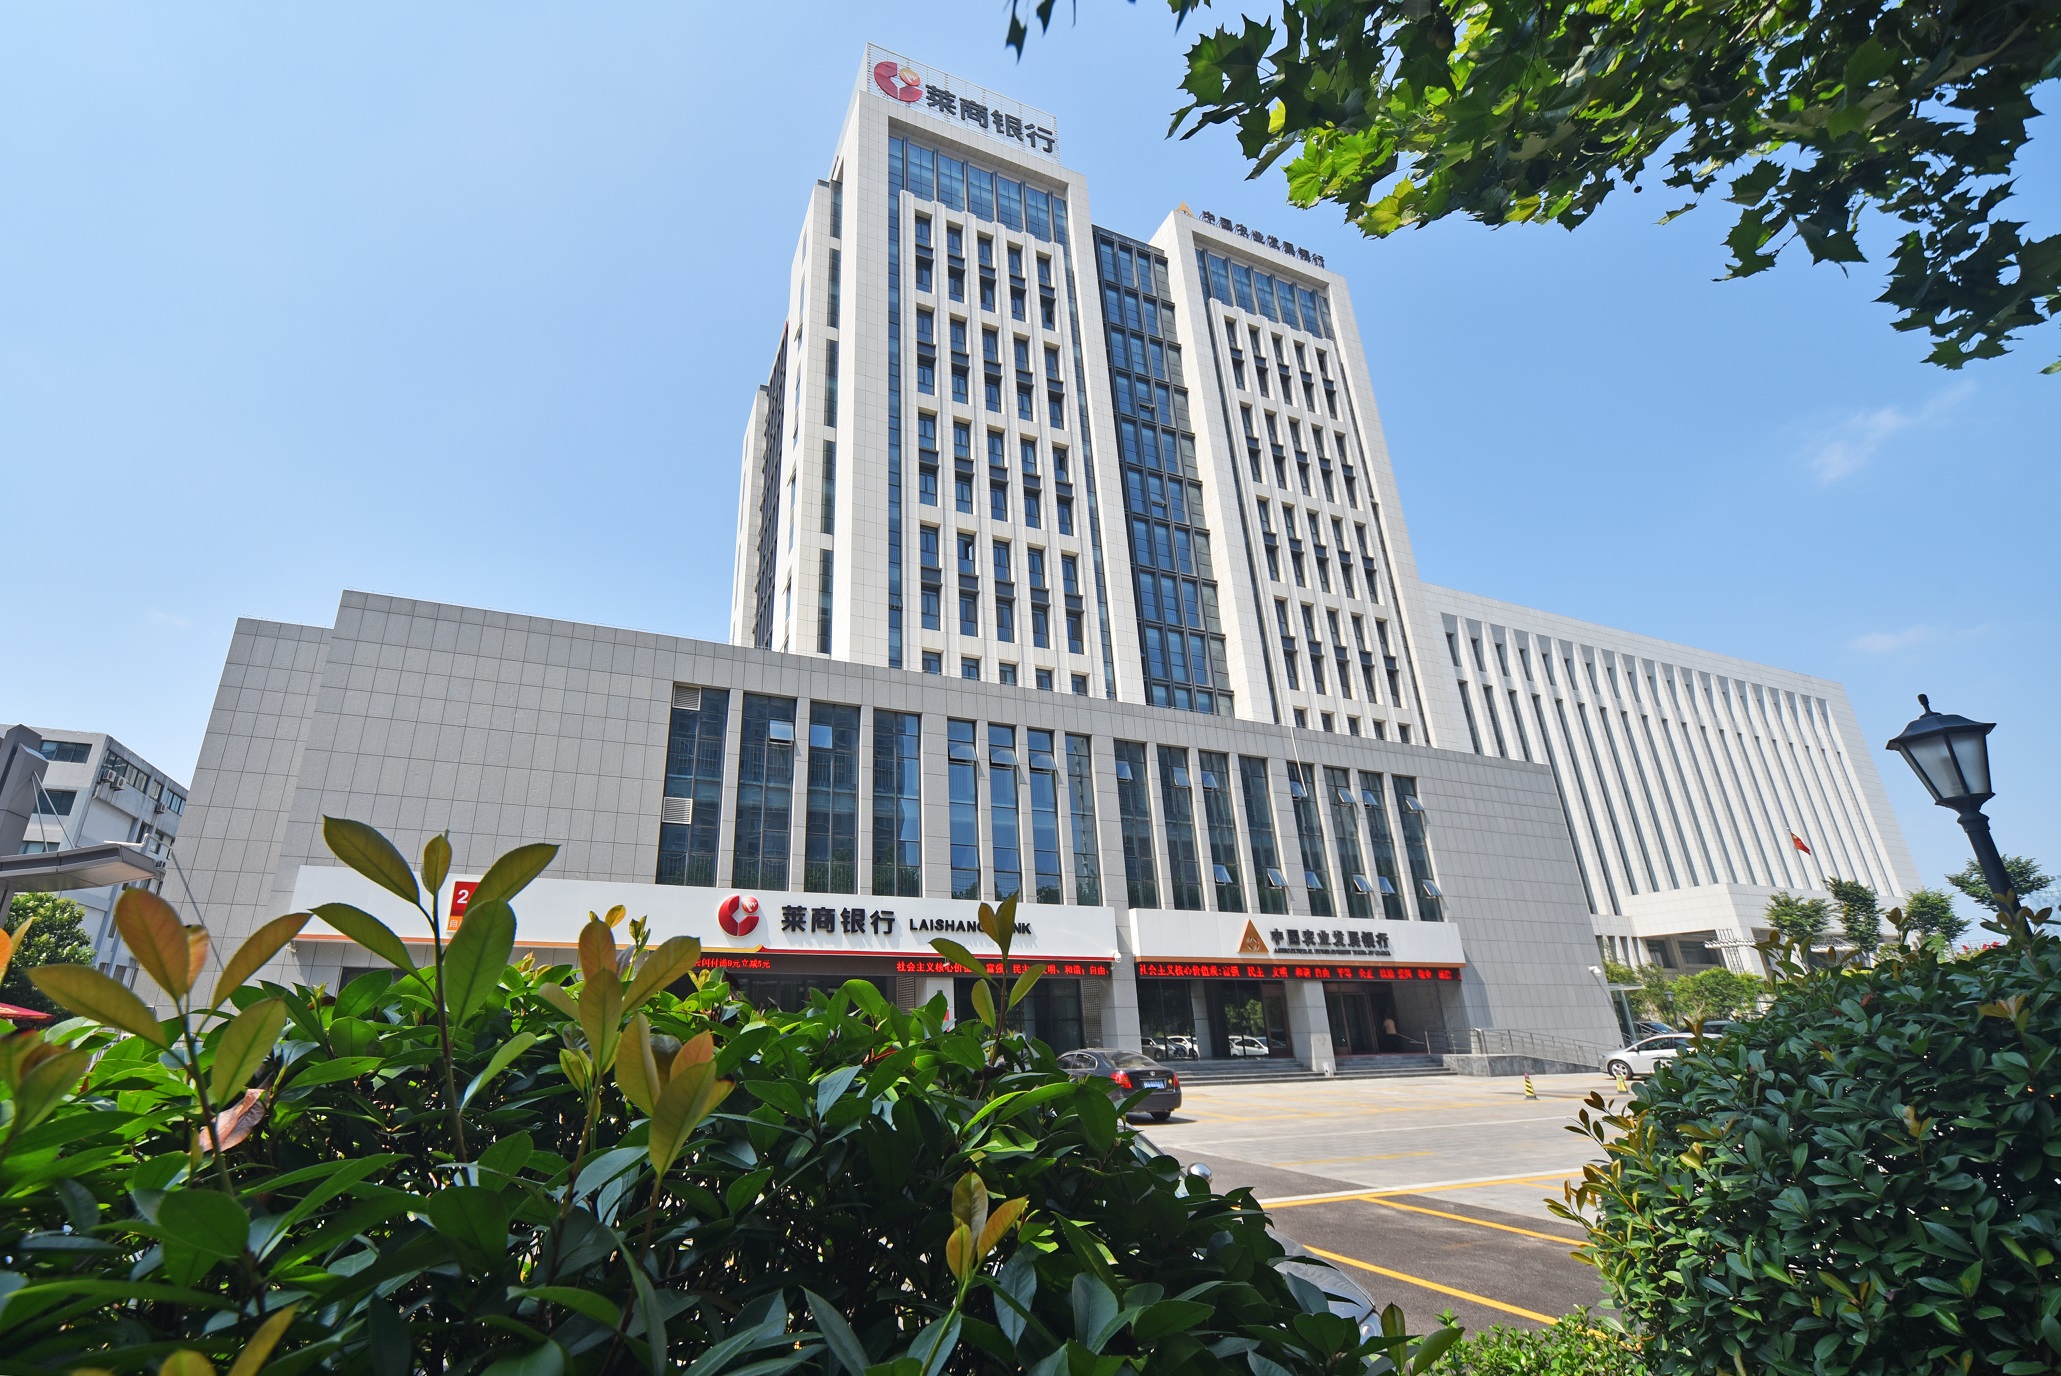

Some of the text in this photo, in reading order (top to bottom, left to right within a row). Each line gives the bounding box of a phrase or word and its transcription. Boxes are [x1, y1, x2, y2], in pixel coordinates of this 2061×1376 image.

[925, 84, 1055, 153] 莱商银行
[457, 889, 469, 904] 2
[781, 905, 896, 935] 莱商银行
[1270, 928, 1390, 948] 中国农业发展银行
